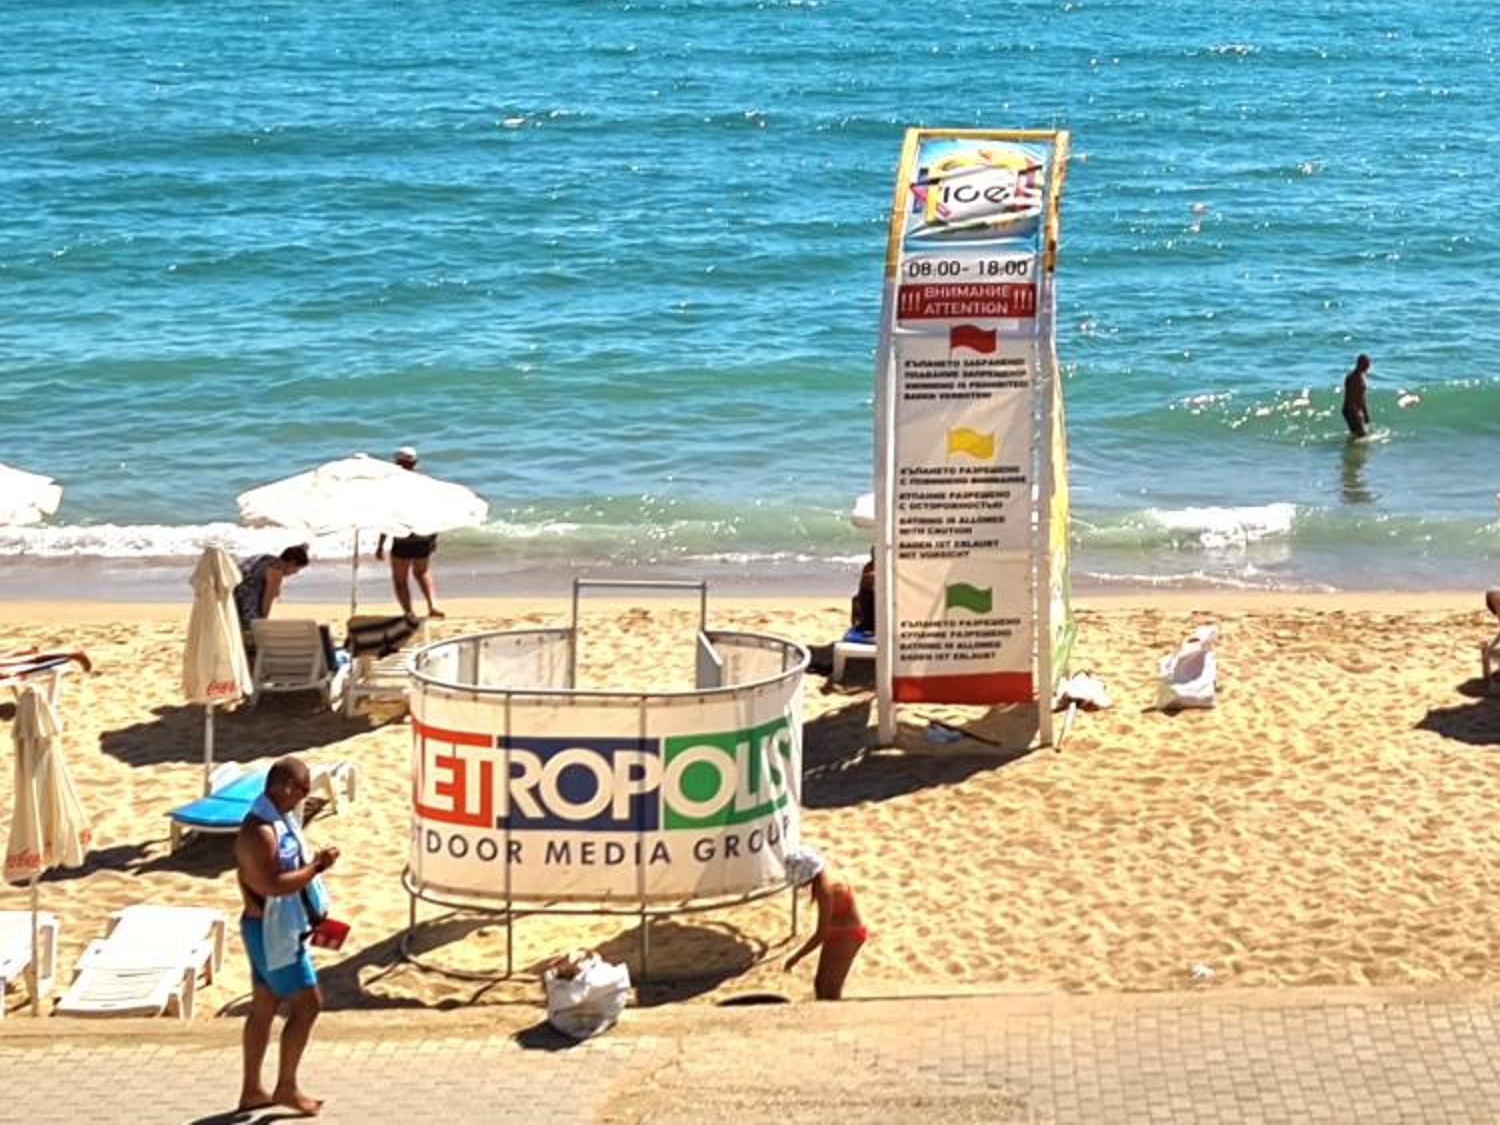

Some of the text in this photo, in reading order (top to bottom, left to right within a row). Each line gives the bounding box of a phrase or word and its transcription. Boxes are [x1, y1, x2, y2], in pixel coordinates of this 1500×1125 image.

[924, 285, 1010, 298] ВНИМАНИЕ
[923, 301, 1009, 316] ATTENTION
[414, 726, 794, 822] ETROPOLIS
[544, 840, 671, 865] MEDIA
[693, 815, 790, 862] GROUP
